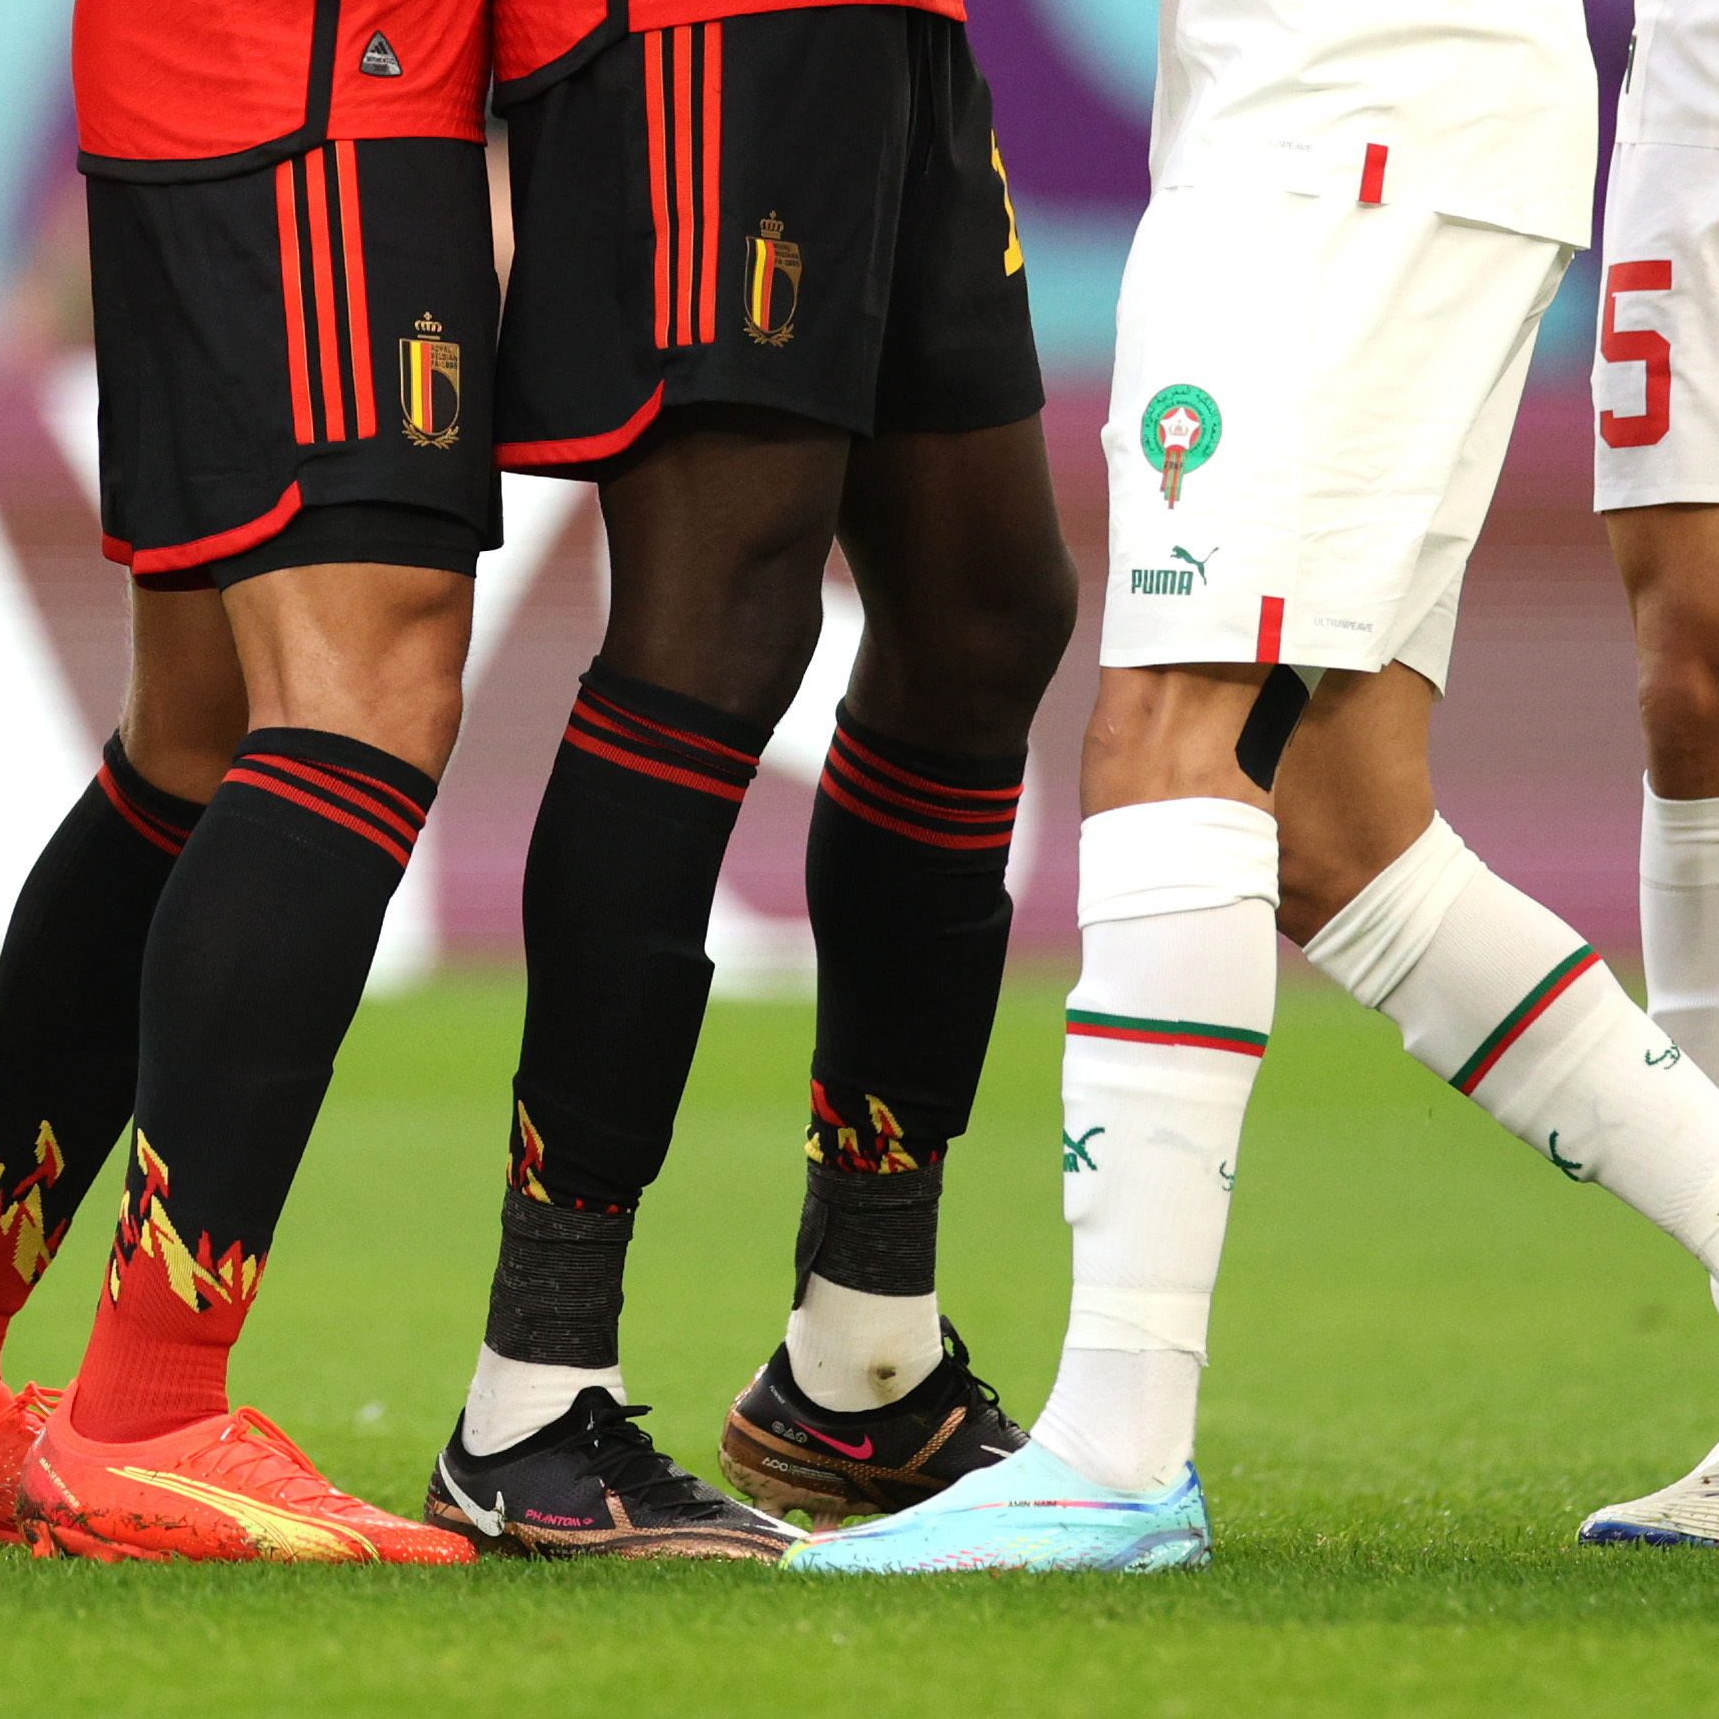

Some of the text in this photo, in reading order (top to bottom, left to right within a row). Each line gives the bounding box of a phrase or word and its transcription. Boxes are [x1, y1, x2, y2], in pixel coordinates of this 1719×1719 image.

[1599, 260, 1672, 449] 5
[1131, 569, 1194, 596] PUMA
[1313, 617, 1374, 633] ULTRAWEAVE
[525, 1508, 581, 1527] PHANTOM
